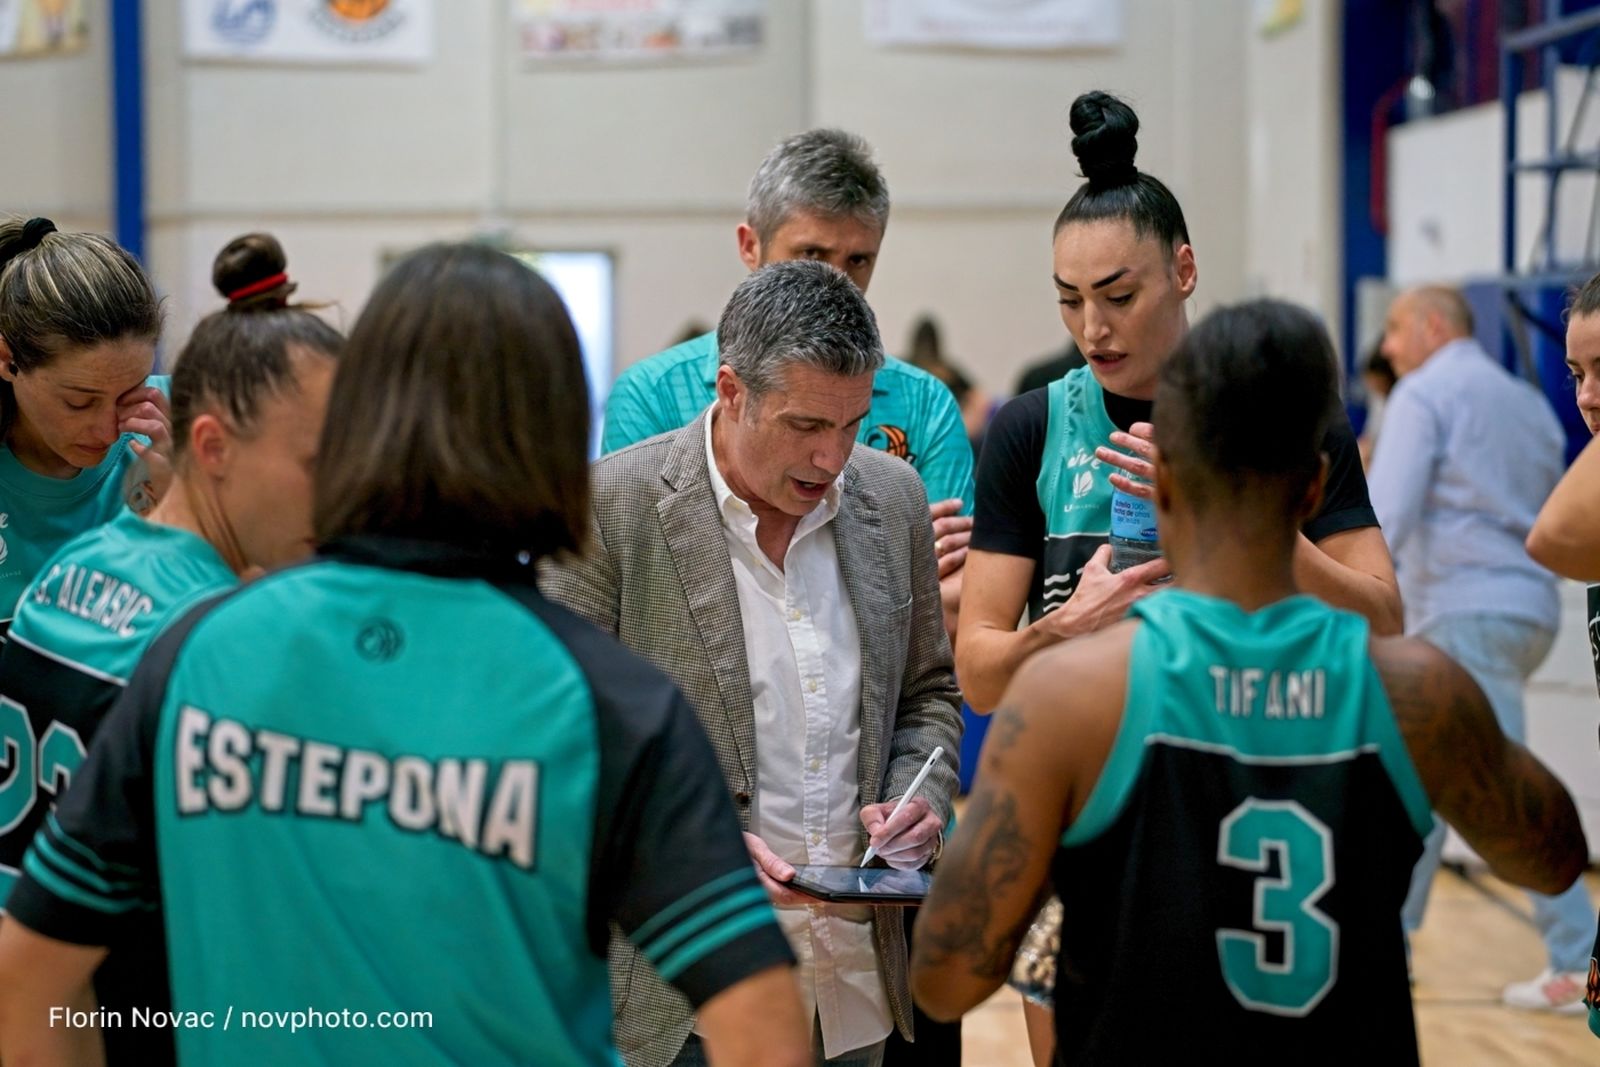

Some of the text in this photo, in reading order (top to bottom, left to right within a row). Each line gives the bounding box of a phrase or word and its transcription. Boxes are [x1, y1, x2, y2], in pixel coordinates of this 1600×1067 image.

[1209, 664, 1326, 719] TIFANI
[174, 702, 539, 874] ESTEPONA
[1215, 796, 1340, 1018] 3
